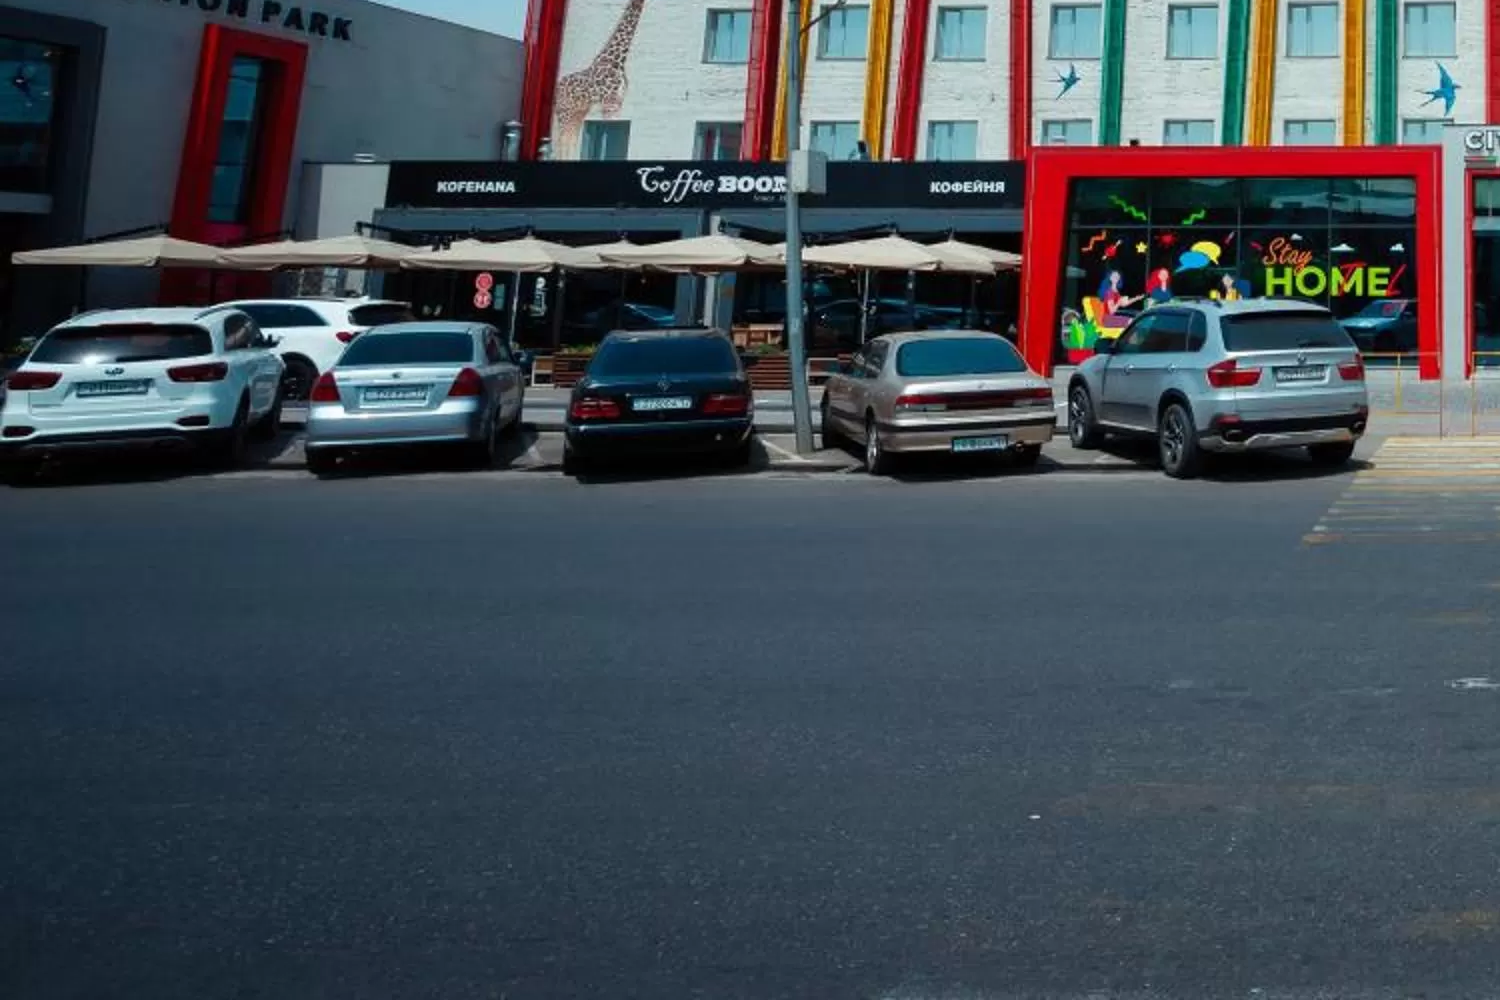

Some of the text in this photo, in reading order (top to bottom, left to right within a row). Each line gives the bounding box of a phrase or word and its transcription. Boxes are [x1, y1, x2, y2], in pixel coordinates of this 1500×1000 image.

[261, 0, 353, 41] PARK
[437, 181, 515, 193] KOFEHANA
[636, 165, 715, 202] Coffee
[930, 179, 1005, 193] КОФЕЙНЯ
[1262, 236, 1313, 276] Stay
